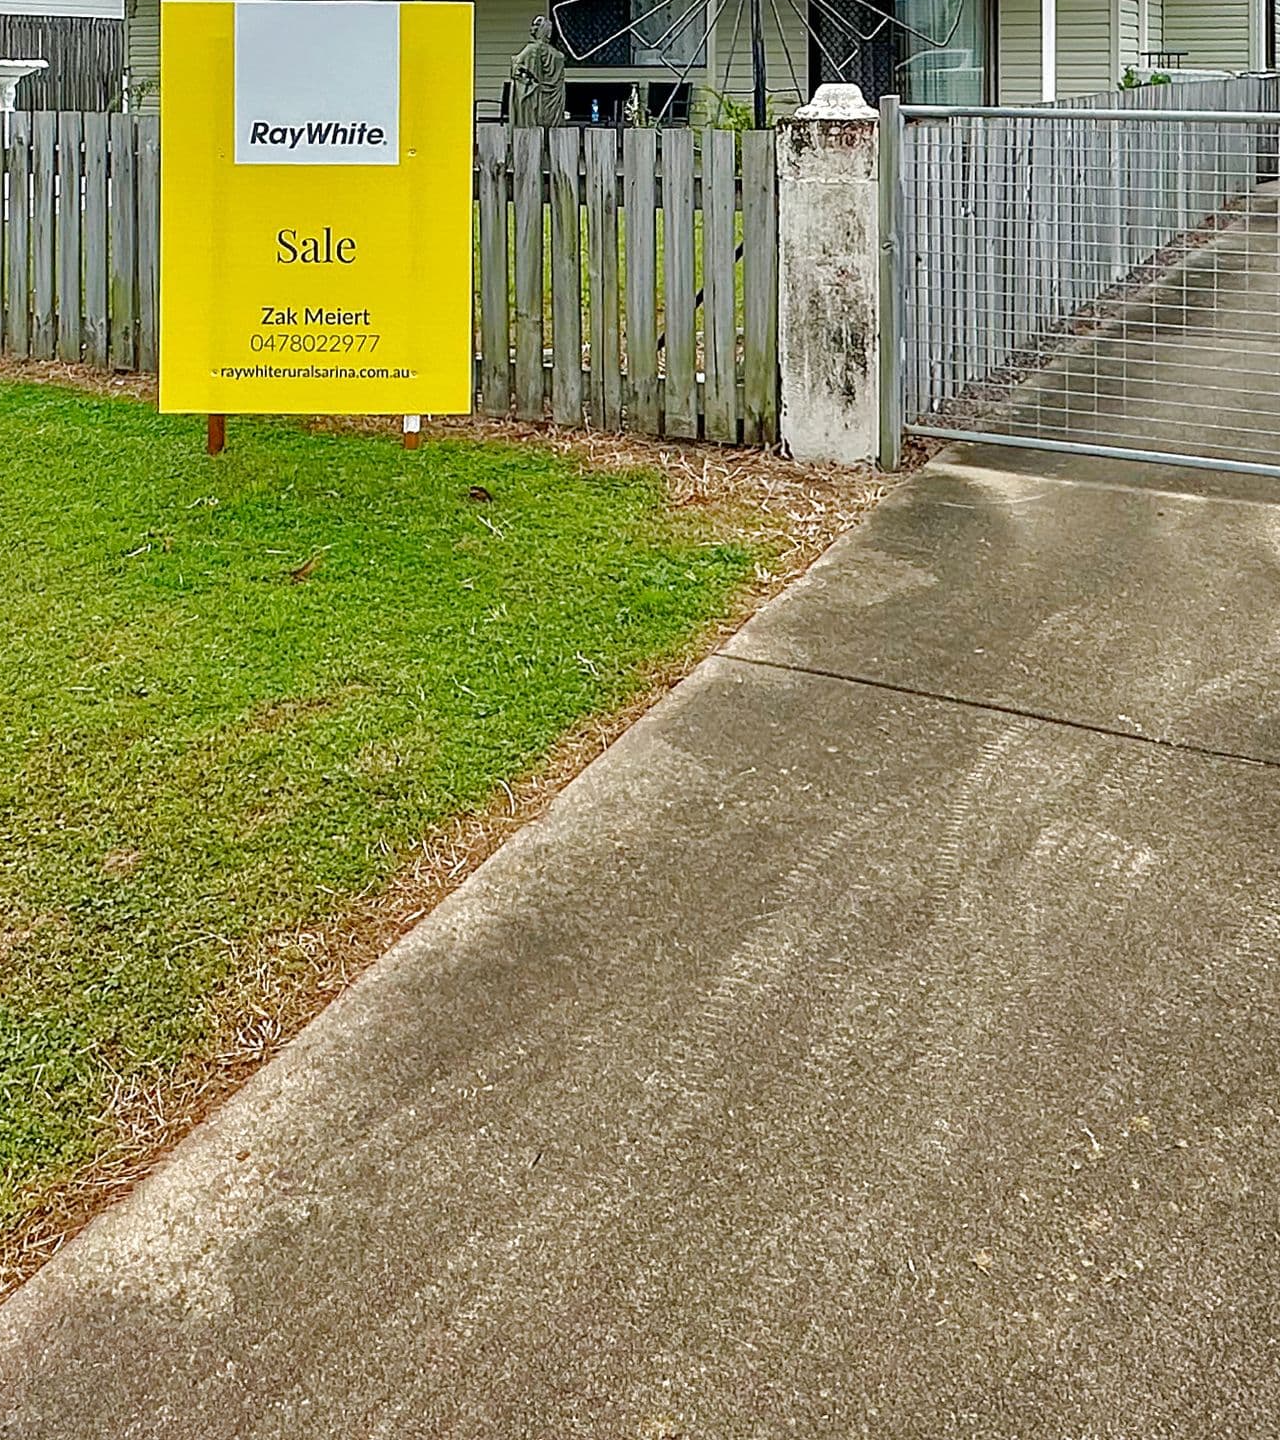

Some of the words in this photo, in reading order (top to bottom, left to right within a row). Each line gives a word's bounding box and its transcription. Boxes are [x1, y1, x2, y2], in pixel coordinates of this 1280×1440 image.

[276, 226, 357, 264] Sale
[261, 307, 298, 326] Zak
[304, 307, 370, 326] Meiert
[250, 334, 380, 353] 0478022977
[221, 364, 410, 379] raywhiteruralsarina.com.au
